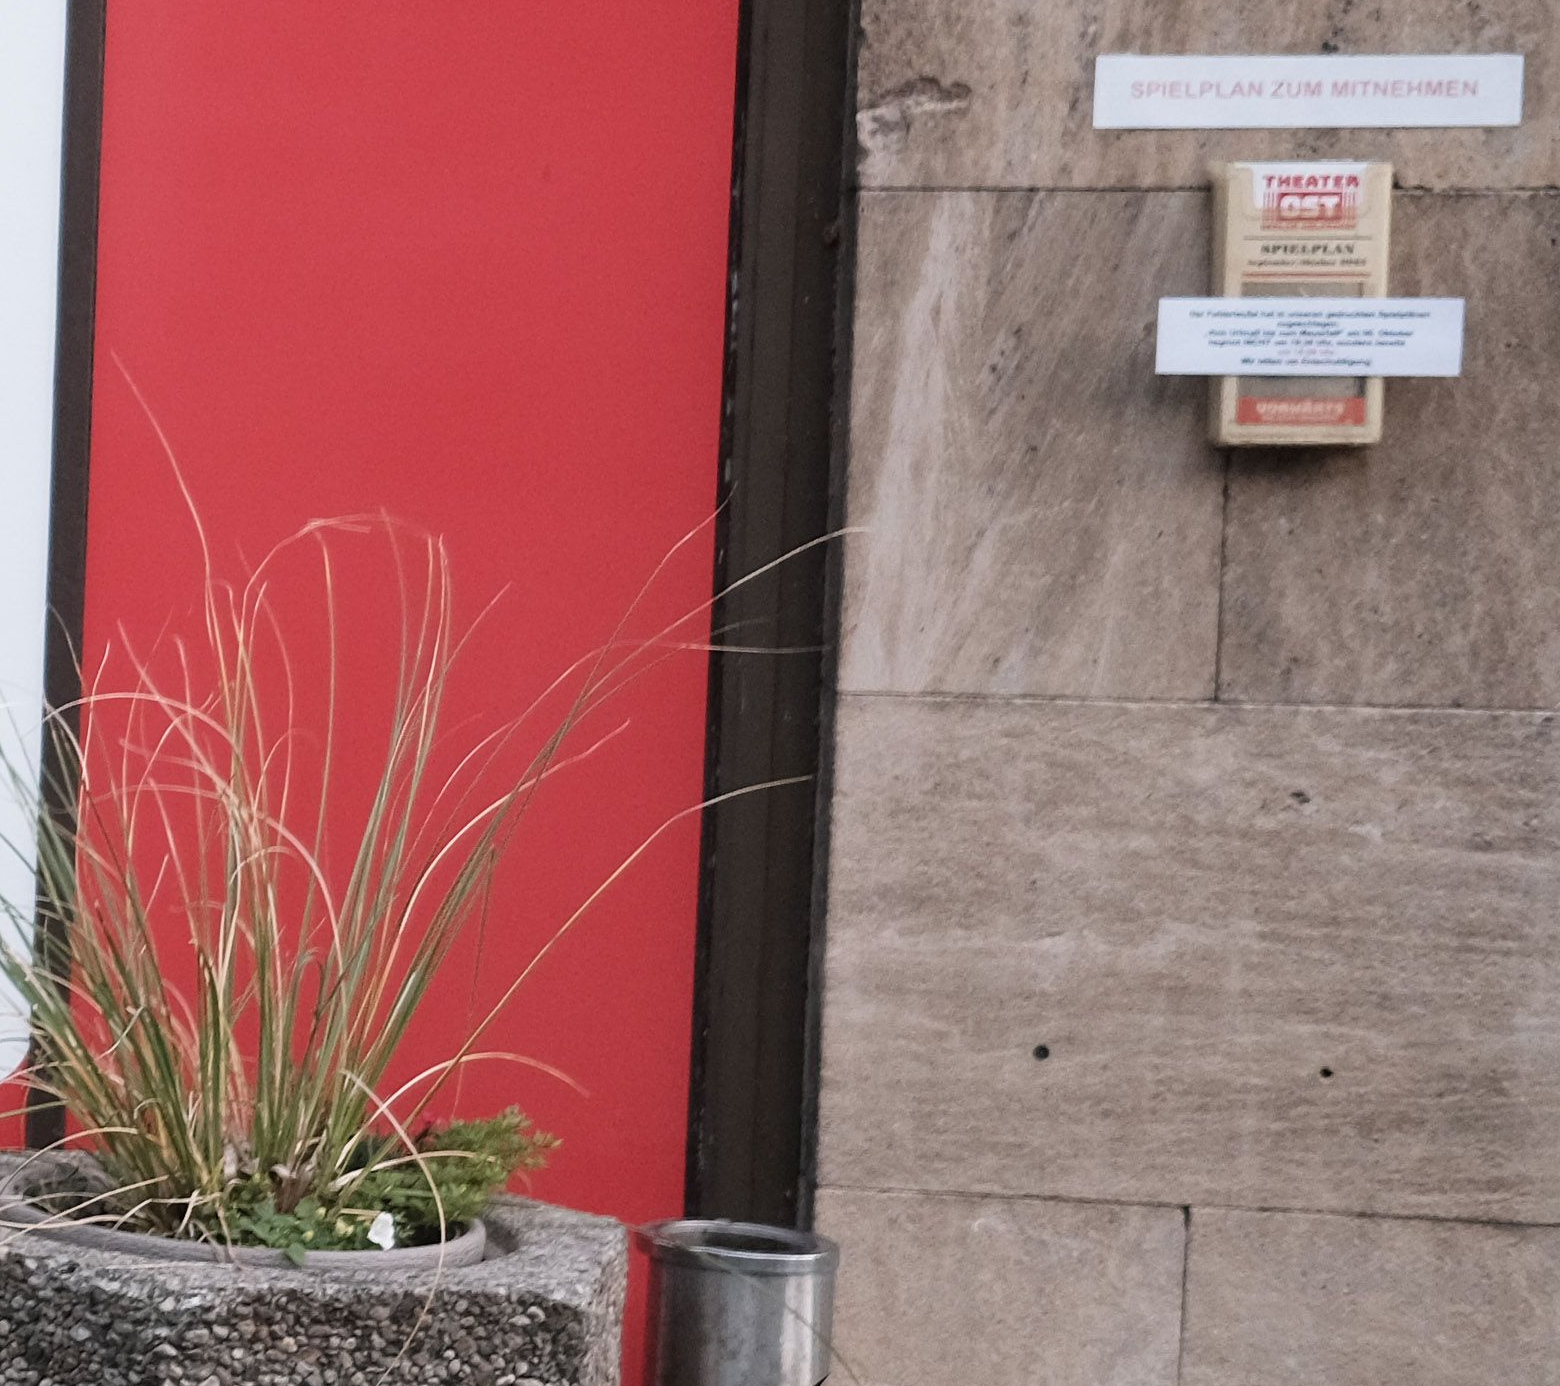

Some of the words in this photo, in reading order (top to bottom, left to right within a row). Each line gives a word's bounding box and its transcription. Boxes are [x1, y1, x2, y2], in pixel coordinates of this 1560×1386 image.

[1130, 80, 1263, 100] SPIELPLAN
[1270, 80, 1322, 99] ZUM
[1331, 79, 1479, 100] MITNEHMEN
[1263, 175, 1360, 188] THEATER
